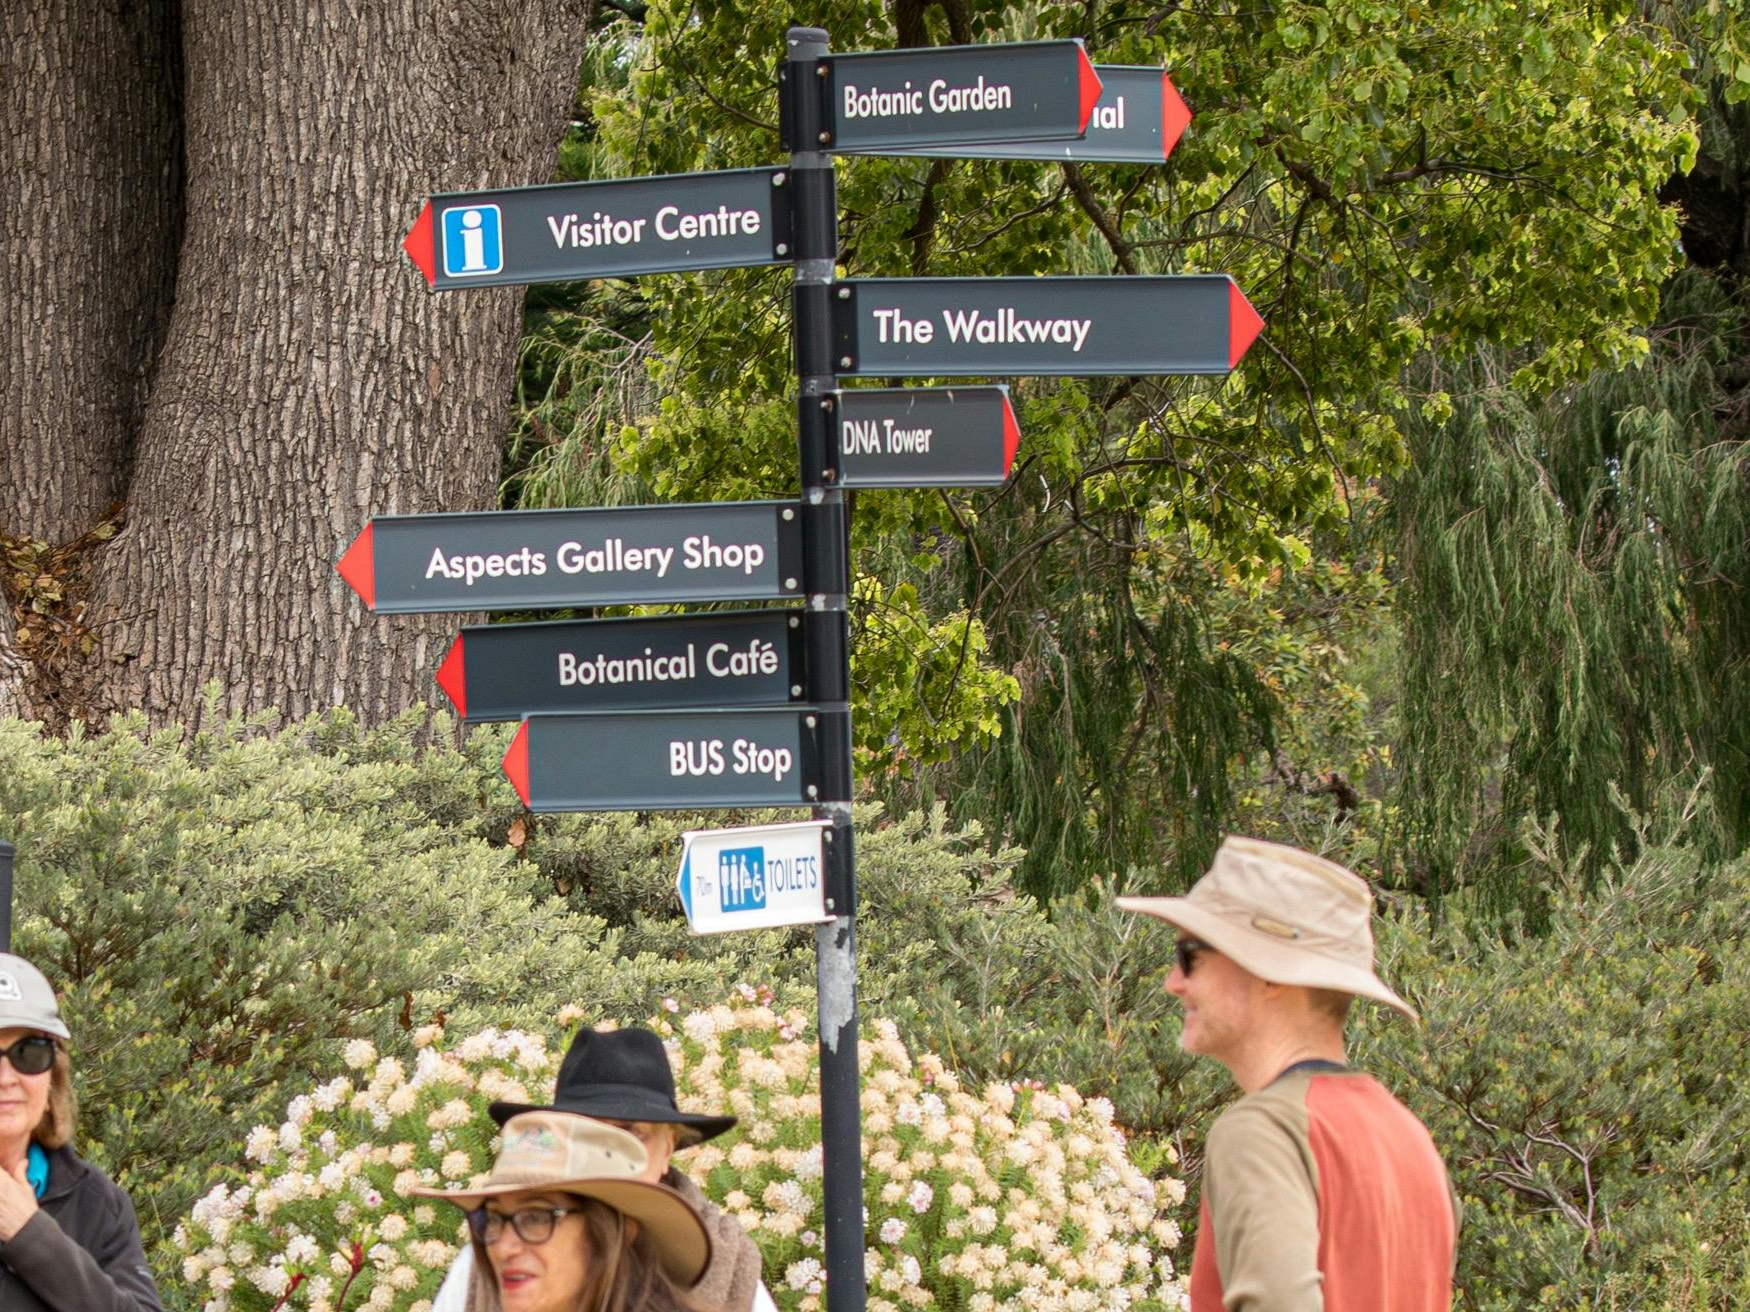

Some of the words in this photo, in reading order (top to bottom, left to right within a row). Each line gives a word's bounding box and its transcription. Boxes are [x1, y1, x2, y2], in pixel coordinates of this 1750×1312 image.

[844, 81, 923, 118] Botanic
[928, 75, 1012, 114] Garden
[547, 211, 647, 249] Visitor
[654, 205, 761, 241] Centre
[872, 308, 934, 344] The
[942, 307, 1092, 352] Walkway
[842, 419, 882, 455] DNA
[883, 418, 933, 454] Tower
[424, 546, 547, 586] Aspects
[556, 537, 674, 578] Gallery
[682, 534, 765, 575] Shop
[558, 643, 696, 686] Botanical
[706, 639, 778, 677] Café
[669, 739, 725, 777] BUS
[732, 738, 792, 782] Stop
[767, 855, 817, 892] TOILETS
